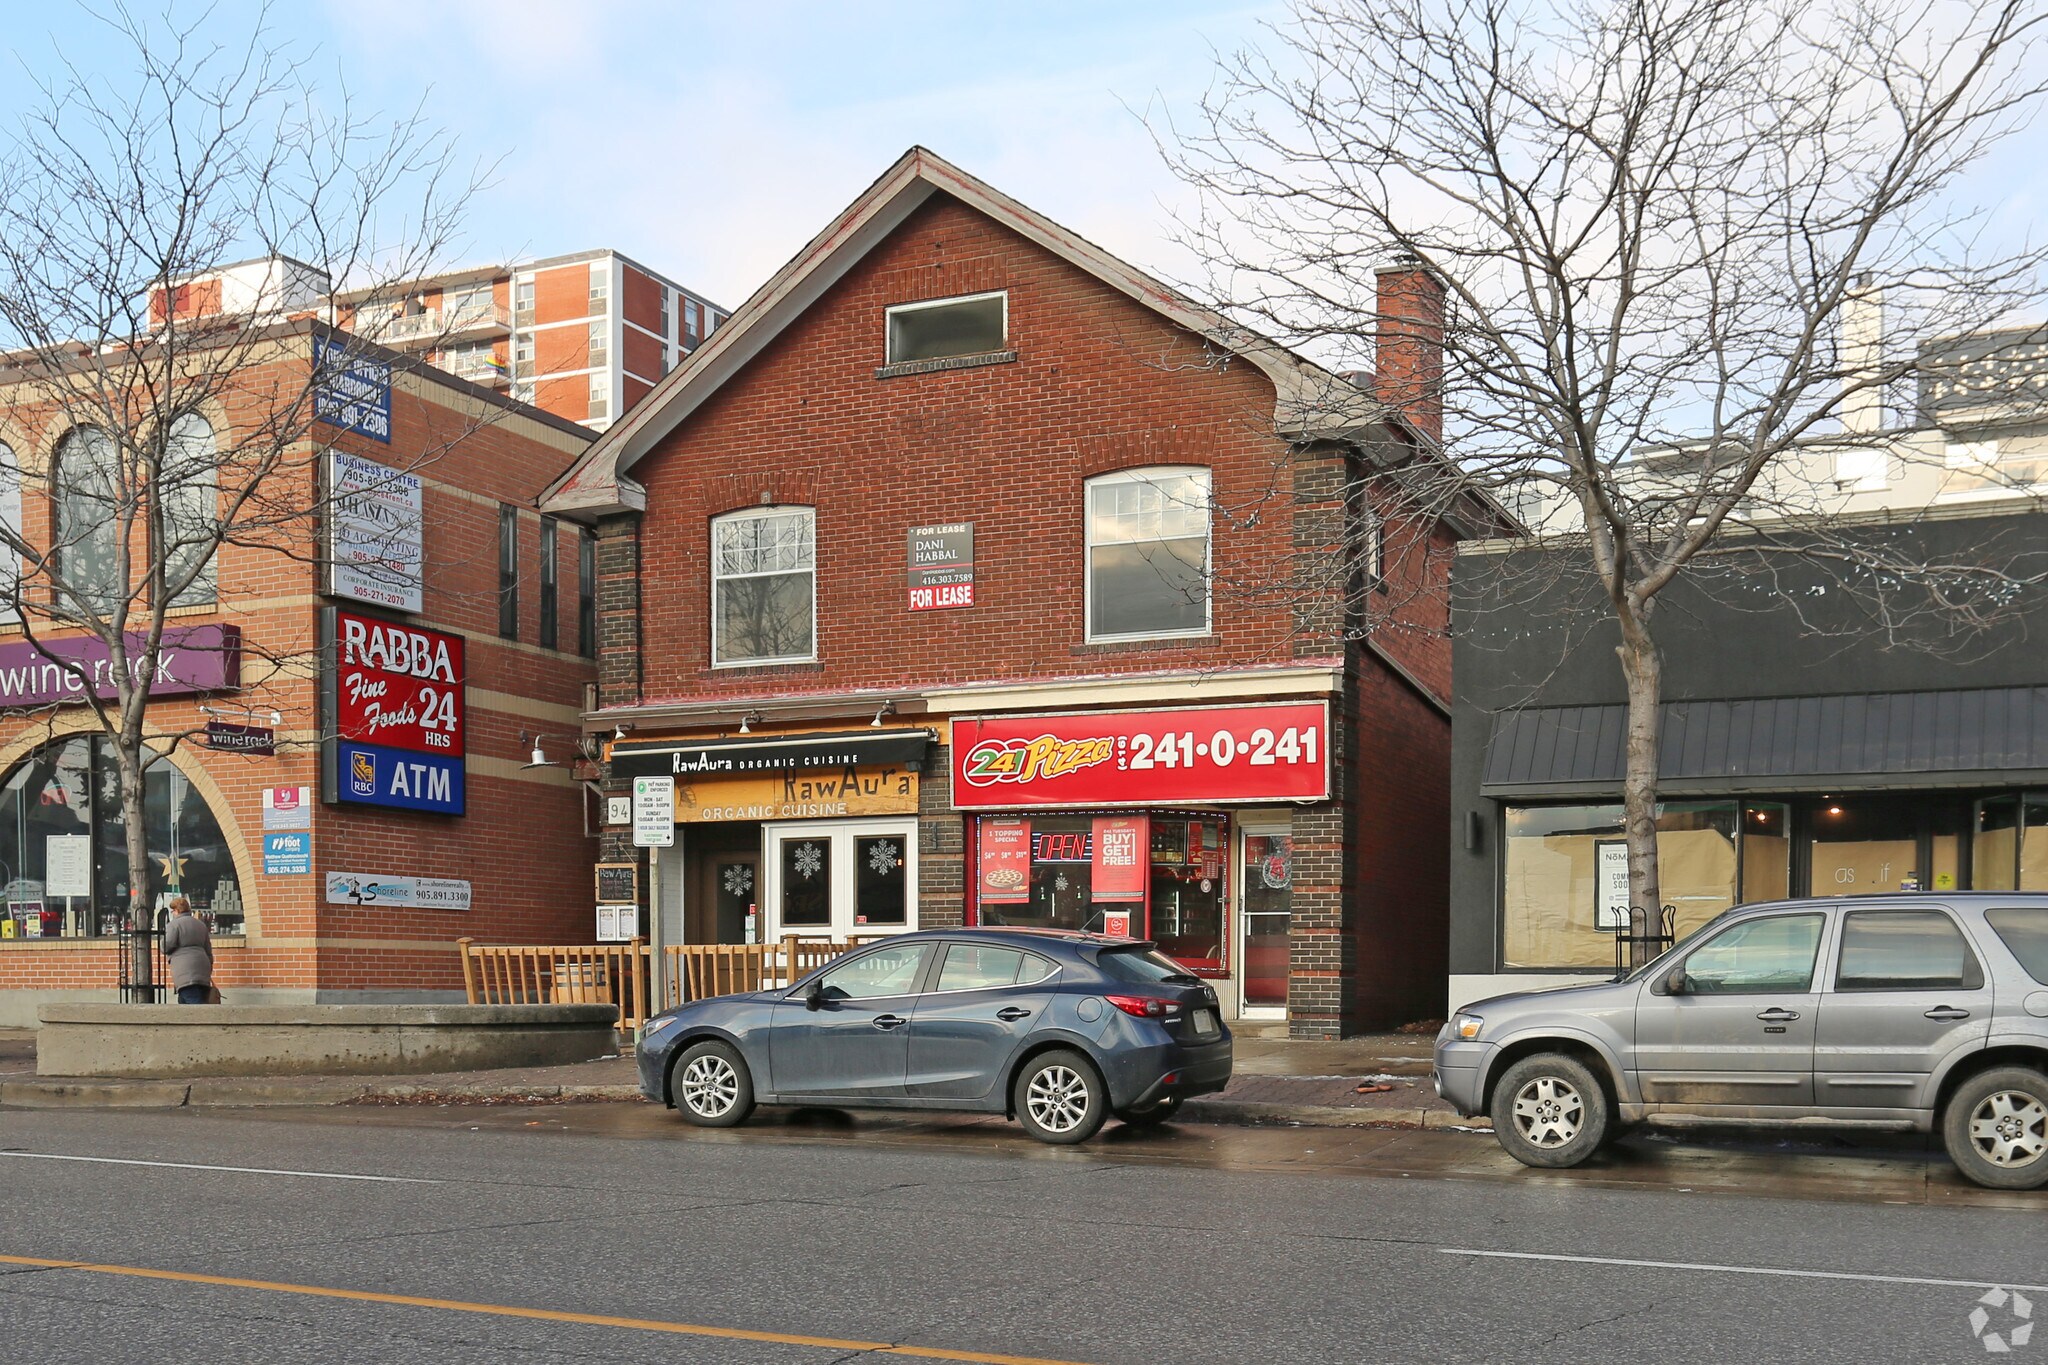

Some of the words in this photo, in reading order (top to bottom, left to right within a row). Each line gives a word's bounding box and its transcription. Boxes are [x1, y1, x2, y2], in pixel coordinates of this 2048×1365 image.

[337, 454, 381, 476] BUSINESS
[384, 470, 419, 488] CENTRE
[917, 527, 934, 536] FOR
[937, 525, 965, 534] LEASE
[353, 531, 419, 557] ACCOUNTING
[916, 539, 944, 551] DANI
[916, 549, 958, 562] HABBAL
[343, 575, 379, 590] CORPORATE
[381, 582, 414, 597] INSURANCE
[922, 573, 973, 585] 416.303.7589
[354, 585, 405, 606] 905-271-2070
[910, 588, 933, 608] FOR
[936, 585, 972, 606] LEASE
[344, 618, 456, 684] RABBA
[345, 672, 387, 706] Fine
[364, 702, 417, 736] Foods
[419, 687, 457, 732] 24
[425, 731, 451, 748] HRS
[673, 752, 732, 773] RawAura
[739, 757, 795, 769] ORGANIC
[804, 754, 858, 766] CUISINE
[1020, 735, 1116, 783] Pizza
[1117, 735, 1128, 771] (416)
[354, 781, 372, 792] RBC
[390, 761, 451, 802] ATM
[611, 804, 628, 818] 94
[702, 805, 775, 821] ORGANIC
[781, 802, 848, 817] CUISINE
[285, 837, 301, 848] foot
[1037, 834, 1086, 860] OPEN
[1103, 834, 1131, 844] BUY
[1103, 845, 1130, 856] GET
[1880, 863, 1890, 882] if
[364, 882, 408, 901] Shoreline
[1613, 881, 1628, 889] SOO
[416, 890, 468, 901] 905.891.3300
